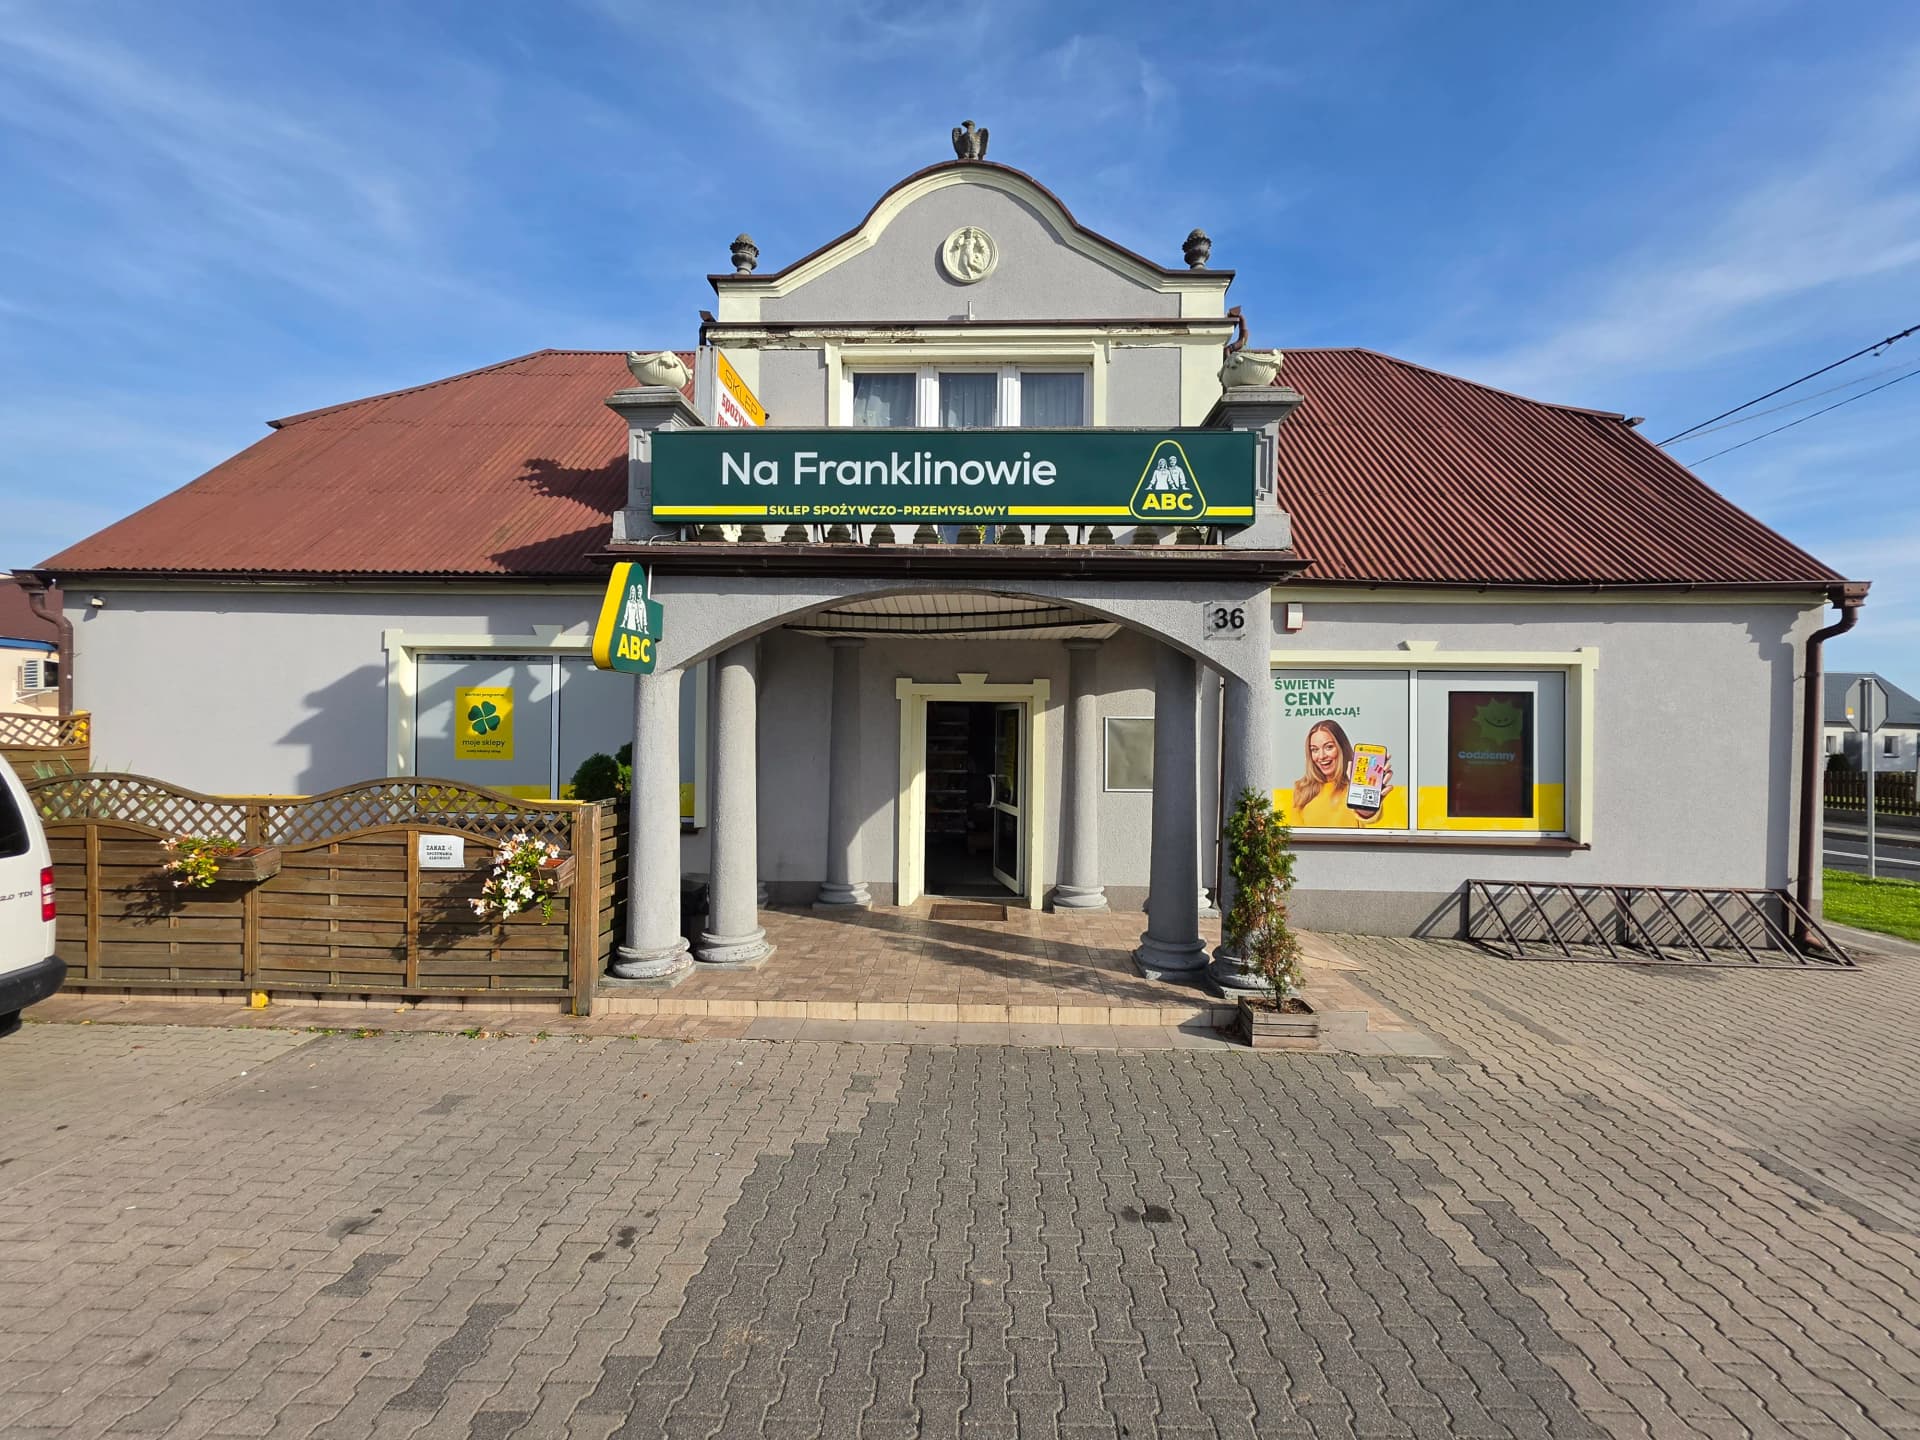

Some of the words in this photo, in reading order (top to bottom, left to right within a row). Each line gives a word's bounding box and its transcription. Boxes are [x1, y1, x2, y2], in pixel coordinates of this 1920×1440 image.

[725, 369, 758, 415] SKLEP
[722, 452, 778, 485] Na
[794, 451, 1057, 486] Franklinowie
[769, 505, 810, 516] SKLEP
[813, 503, 1006, 517] SPOŻYWCZO-PRZEMYSŁOWY
[1142, 493, 1194, 511] ABC
[1215, 608, 1244, 629] 36
[616, 633, 651, 663] ABC
[1274, 677, 1335, 690] ŚWIETNE
[1284, 692, 1334, 706] CENY
[1295, 707, 1360, 717] APLIKACJĄ!
[18, 890, 33, 898] TDI
